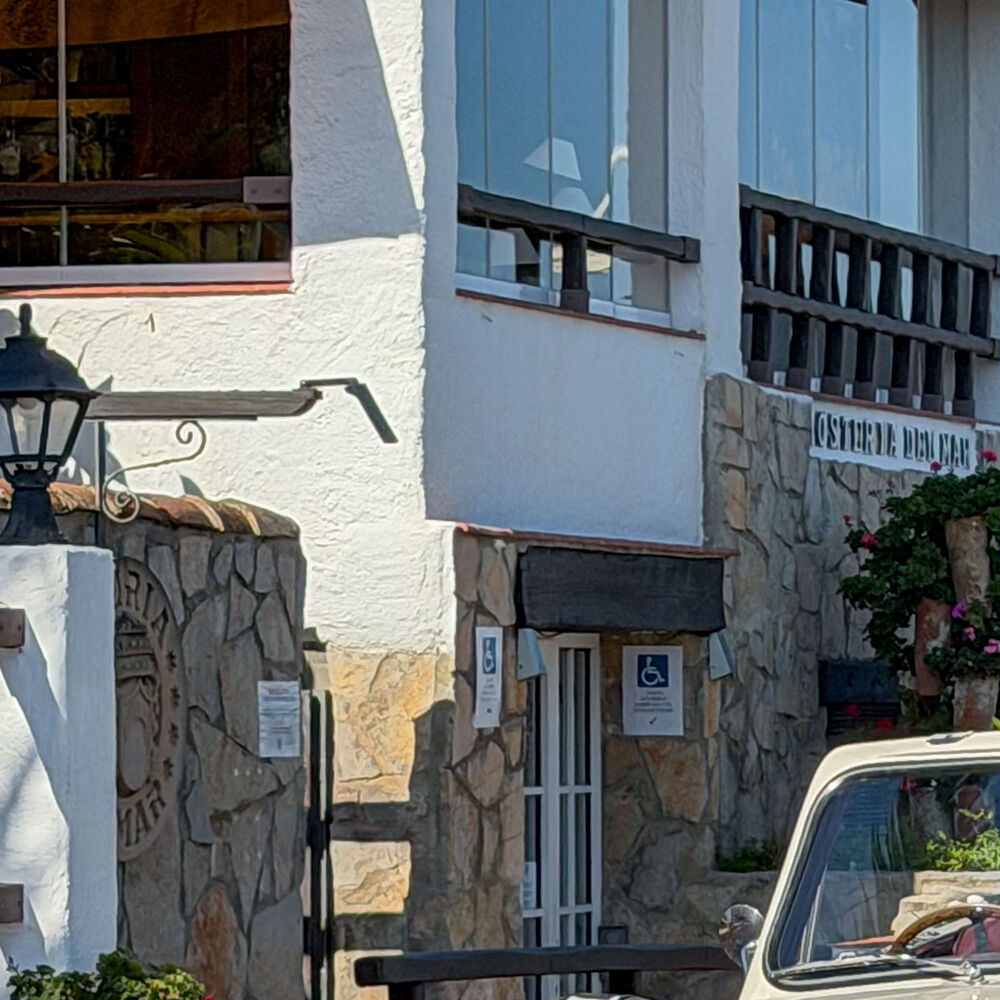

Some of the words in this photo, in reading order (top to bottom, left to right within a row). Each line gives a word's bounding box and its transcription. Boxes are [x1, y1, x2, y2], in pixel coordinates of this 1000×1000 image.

[903, 426, 935, 463] DEL
[938, 432, 972, 471] MAR
[117, 568, 170, 645] RIA
